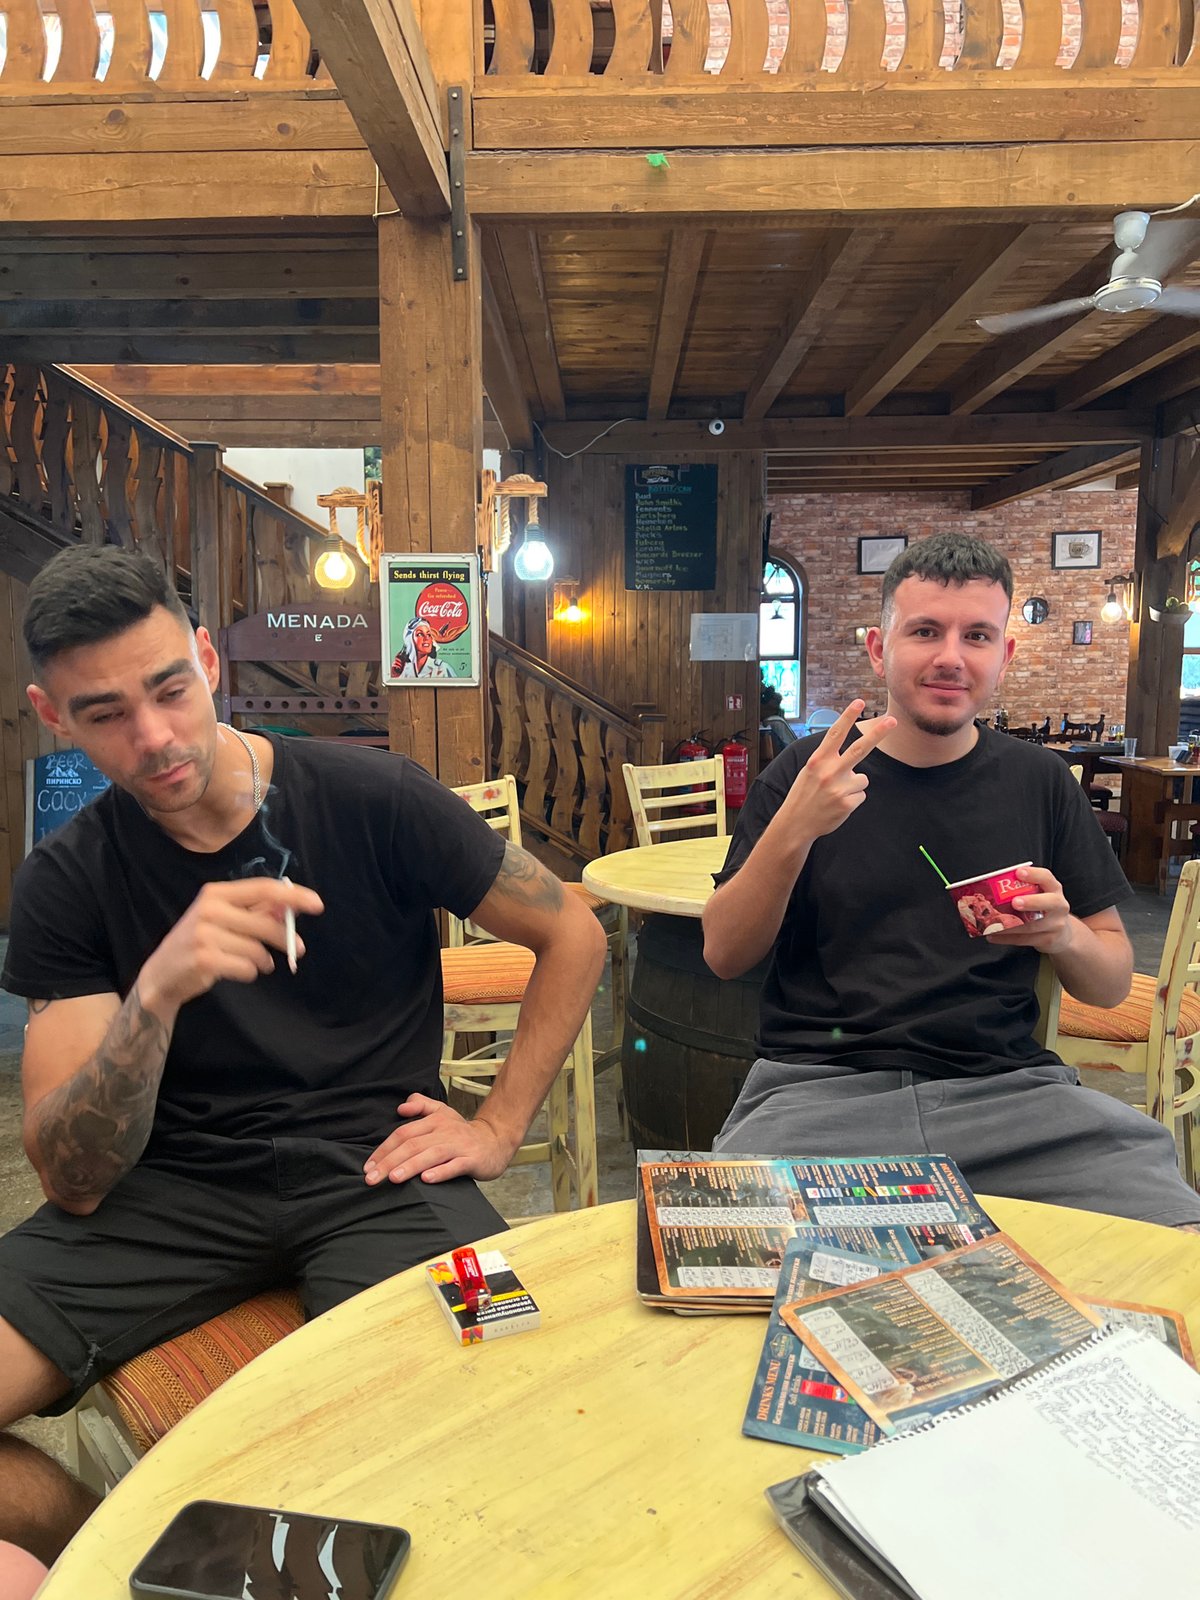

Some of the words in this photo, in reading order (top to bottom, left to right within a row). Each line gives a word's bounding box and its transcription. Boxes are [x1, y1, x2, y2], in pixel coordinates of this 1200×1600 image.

[393, 570, 416, 579] Sends
[419, 570, 440, 579] thirst
[442, 570, 465, 581] flying
[675, 564, 689, 572] Ice
[418, 601, 464, 618] Coca-Cola
[267, 613, 368, 629] MENADA
[314, 633, 323, 642] E
[940, 1163, 958, 1185] DRINKS
[953, 1184, 969, 1203] MENU
[757, 1384, 774, 1421] DRINKS
[766, 1360, 781, 1385] MENU
[792, 1375, 801, 1393] drinks
[788, 1392, 798, 1405] Soft
